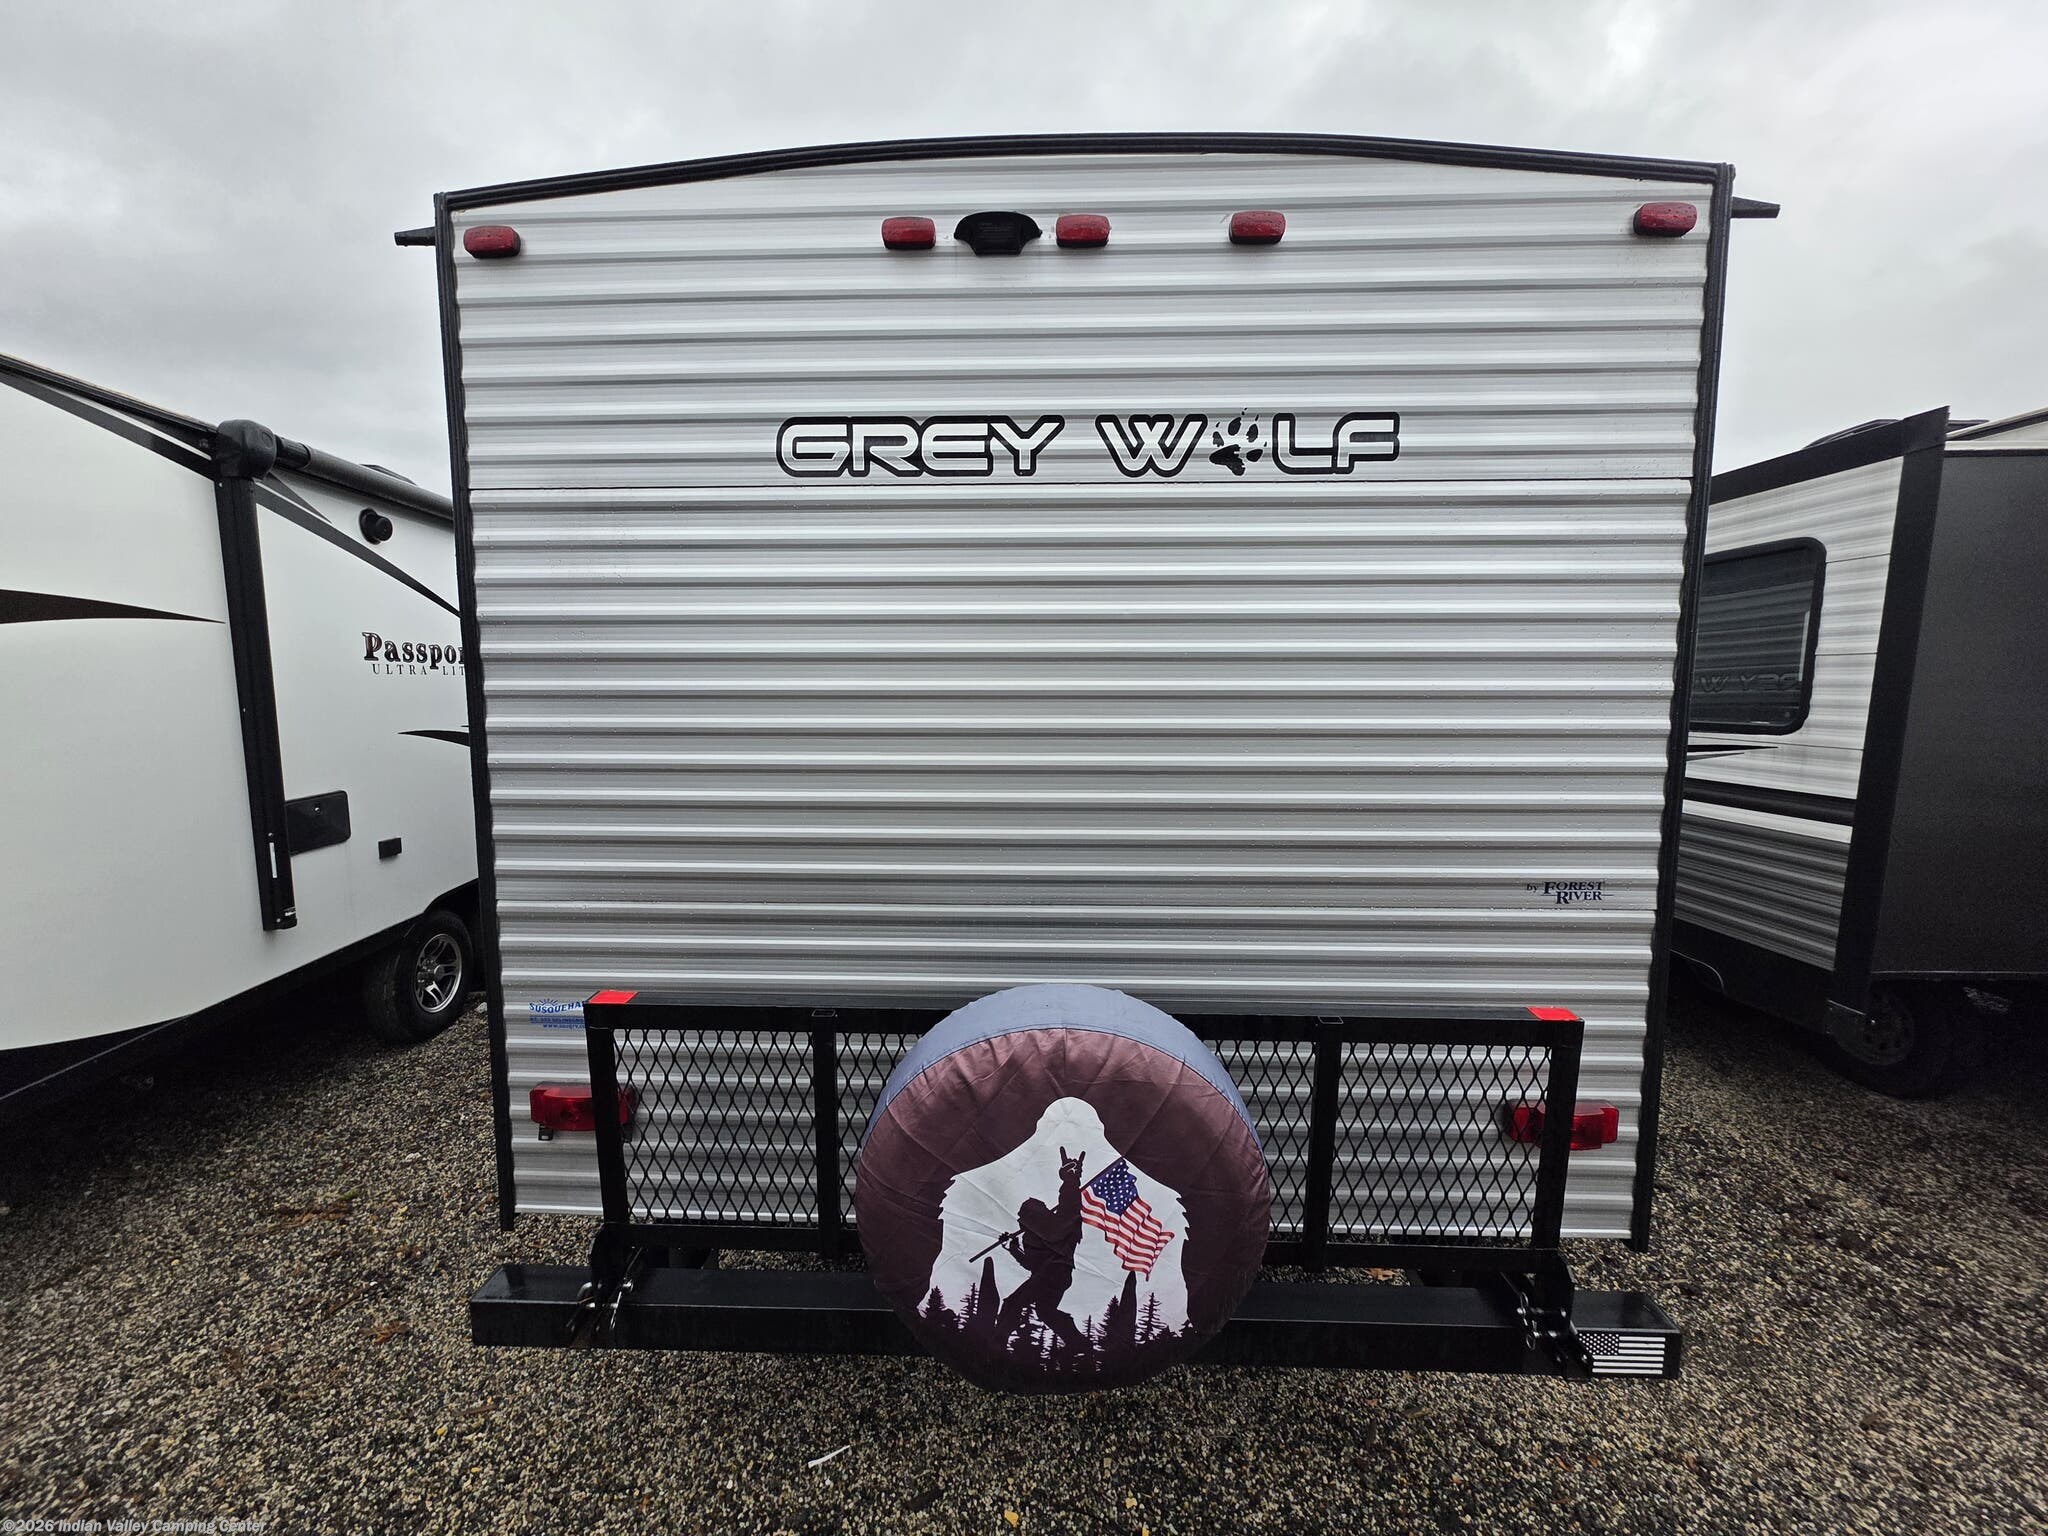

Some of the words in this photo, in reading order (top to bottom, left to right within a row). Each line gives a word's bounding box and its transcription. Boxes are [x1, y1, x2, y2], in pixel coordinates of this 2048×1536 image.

[776, 415, 1065, 477] GREY
[1095, 409, 1400, 477] WLF
[372, 663, 427, 675] ULTRA
[1526, 883, 1539, 893] by
[1543, 881, 1604, 894] FOREST
[1555, 891, 1602, 905] RIVER
